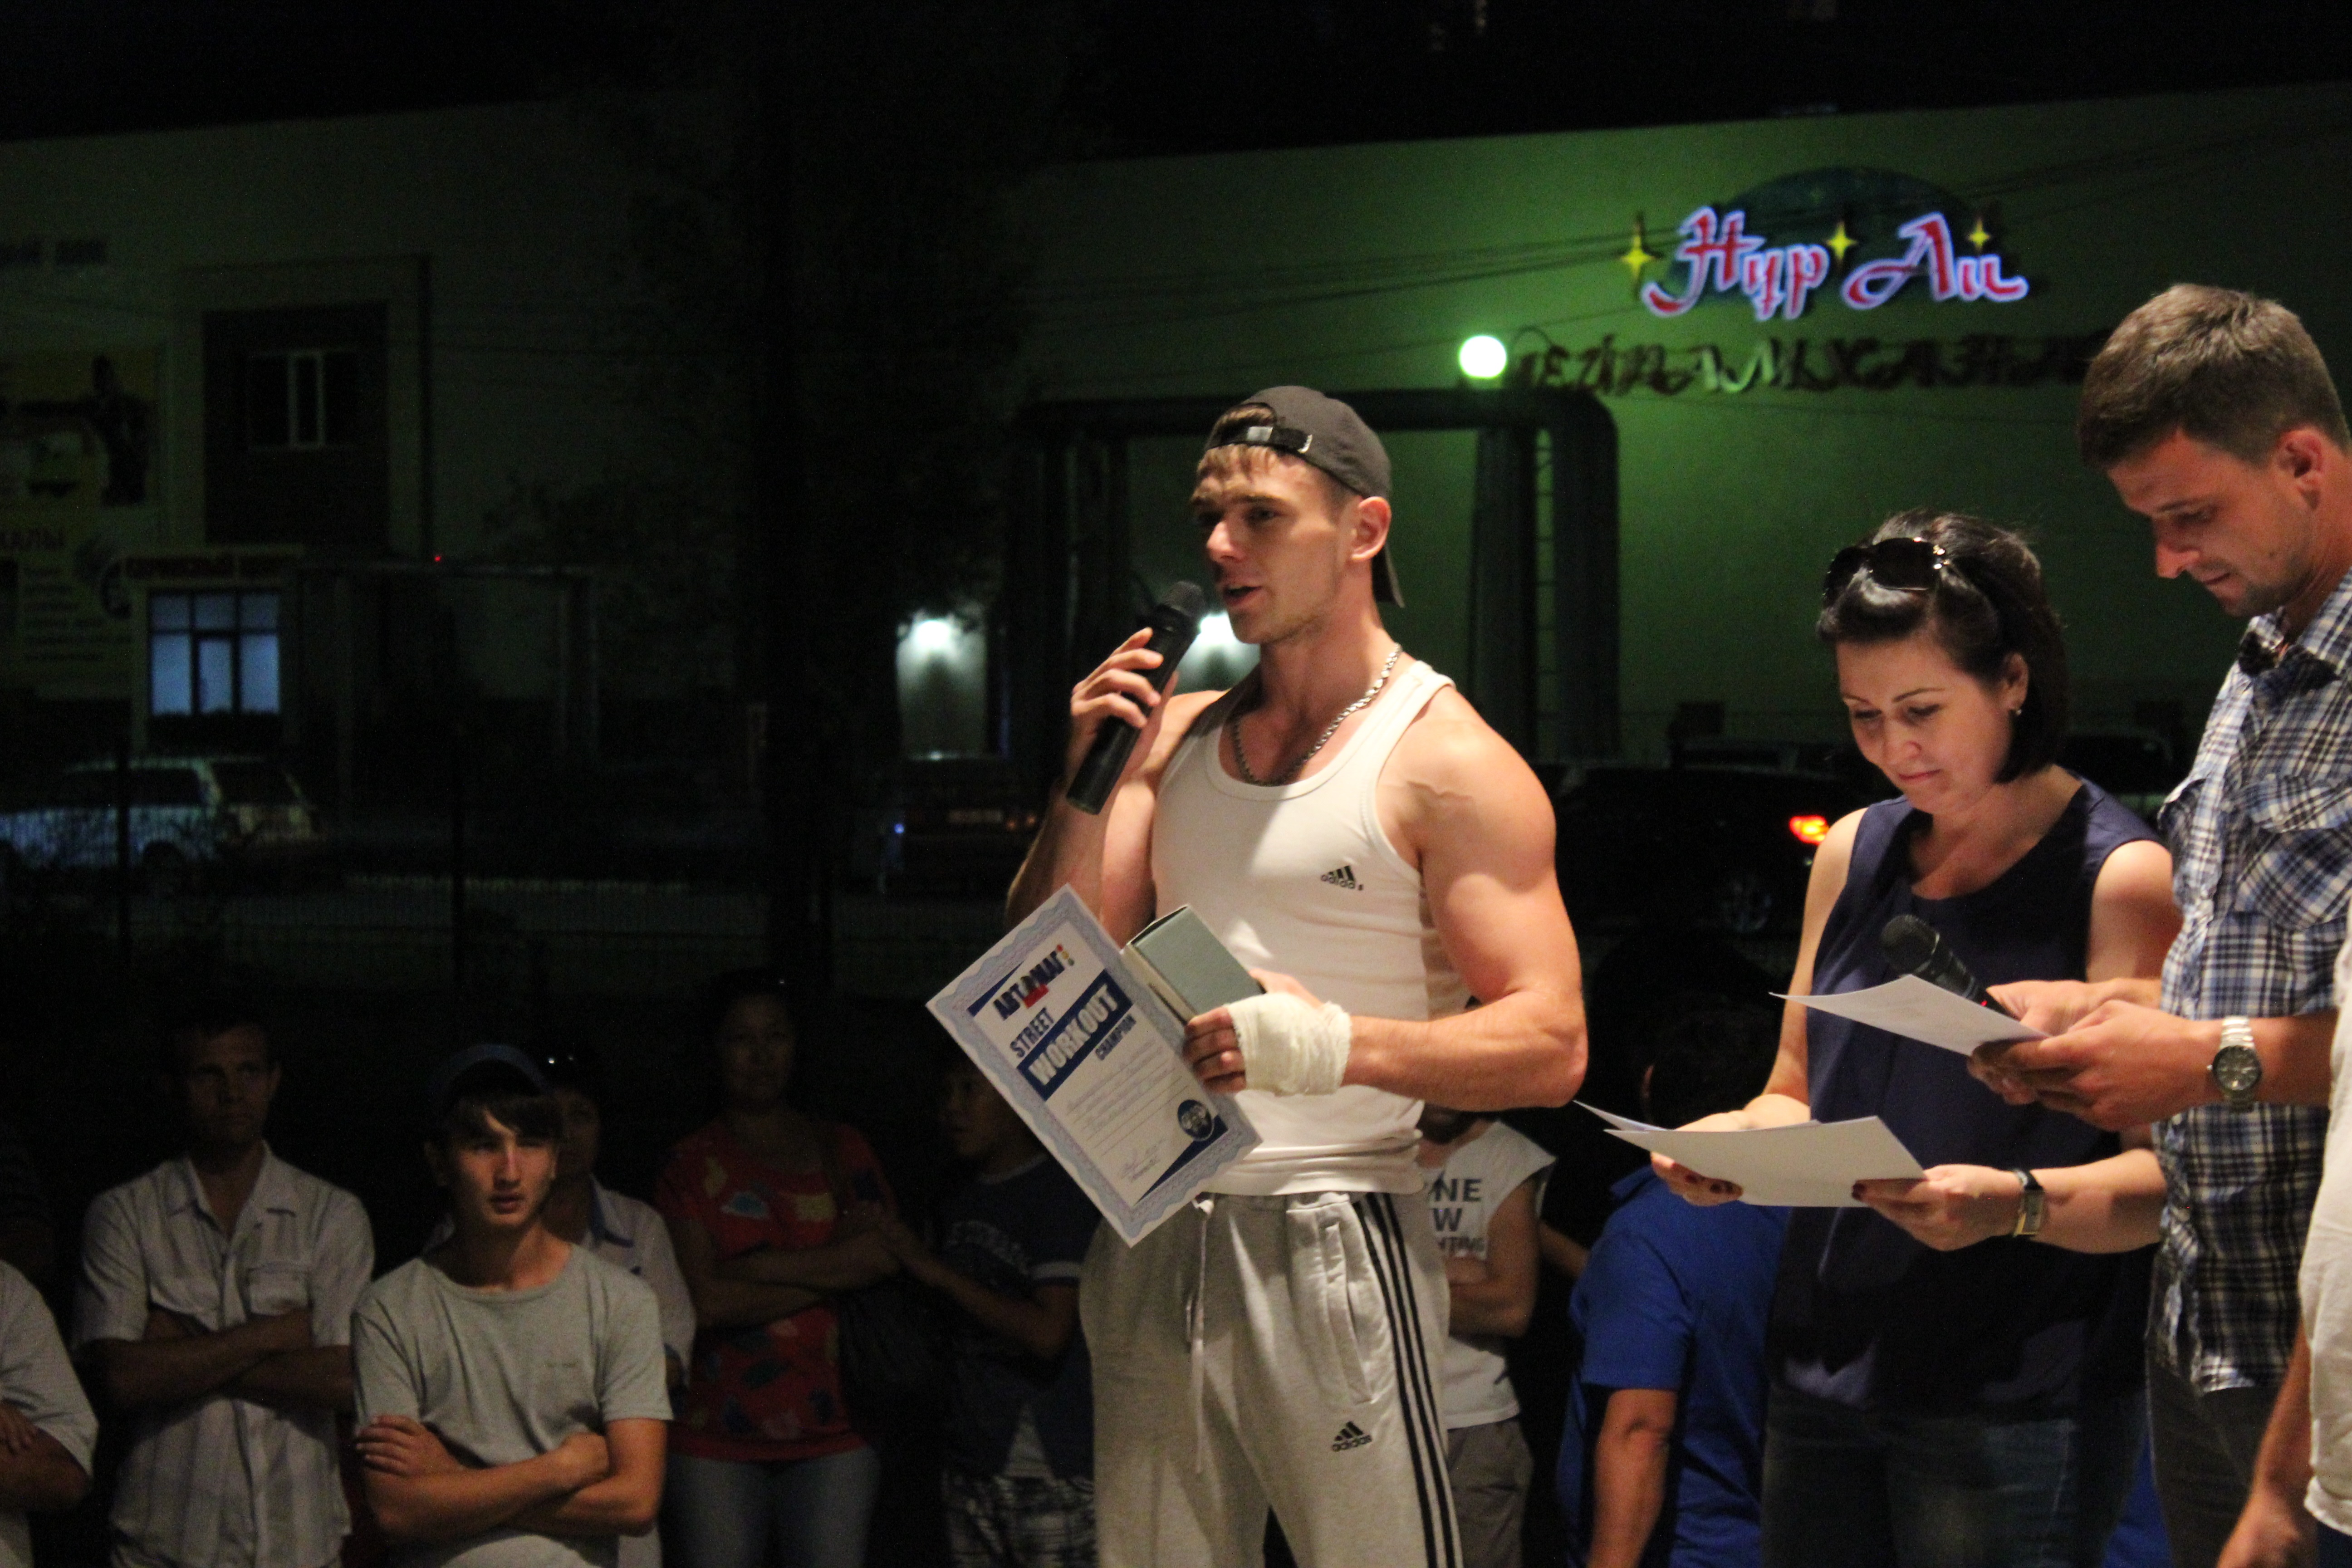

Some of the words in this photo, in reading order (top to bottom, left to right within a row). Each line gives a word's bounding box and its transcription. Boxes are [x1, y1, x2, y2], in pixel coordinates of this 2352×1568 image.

[1009, 1007, 1054, 1058] STREET
[1028, 983, 1118, 1085] WORKOUT
[1095, 1014, 1137, 1061] CHAMPION
